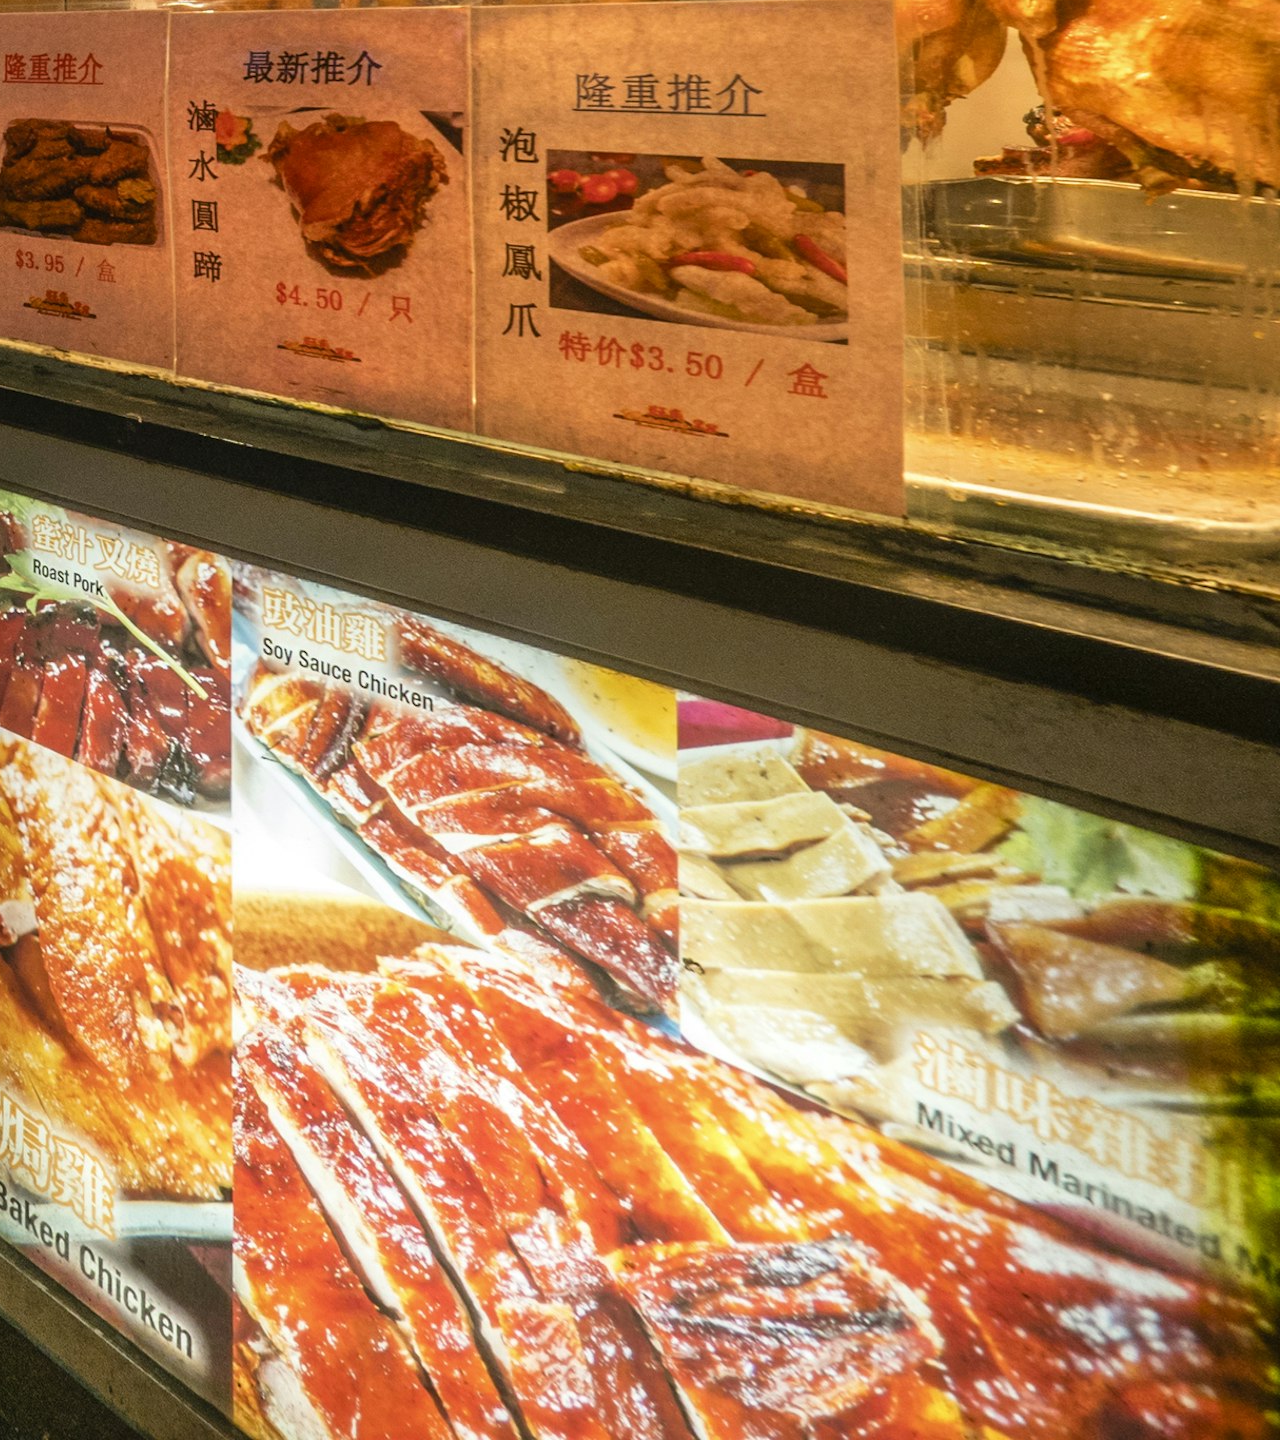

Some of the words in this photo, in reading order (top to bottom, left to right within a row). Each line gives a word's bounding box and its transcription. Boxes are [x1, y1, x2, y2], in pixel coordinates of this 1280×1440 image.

[2, 51, 105, 85] 隆重推介
[242, 50, 383, 87] 最新推介
[573, 72, 765, 115] 隆重推介
[498, 125, 543, 339] 泡椒鳳爪
[14, 247, 65, 275] $3.95
[275, 281, 343, 313] $4.50
[389, 295, 413, 325] 只
[786, 363, 830, 401] 盒
[31, 512, 161, 590] 蜜汁叉燒
[31, 556, 70, 590] Roast
[72, 568, 105, 598] Pork
[261, 636, 293, 670] Soy
[297, 648, 353, 688] Sauce
[357, 668, 435, 714] Chicken
[916, 1100, 1017, 1168] Mixed
[1028, 1150, 1223, 1261] Marinated
[79, 1244, 194, 1360] Chicken
